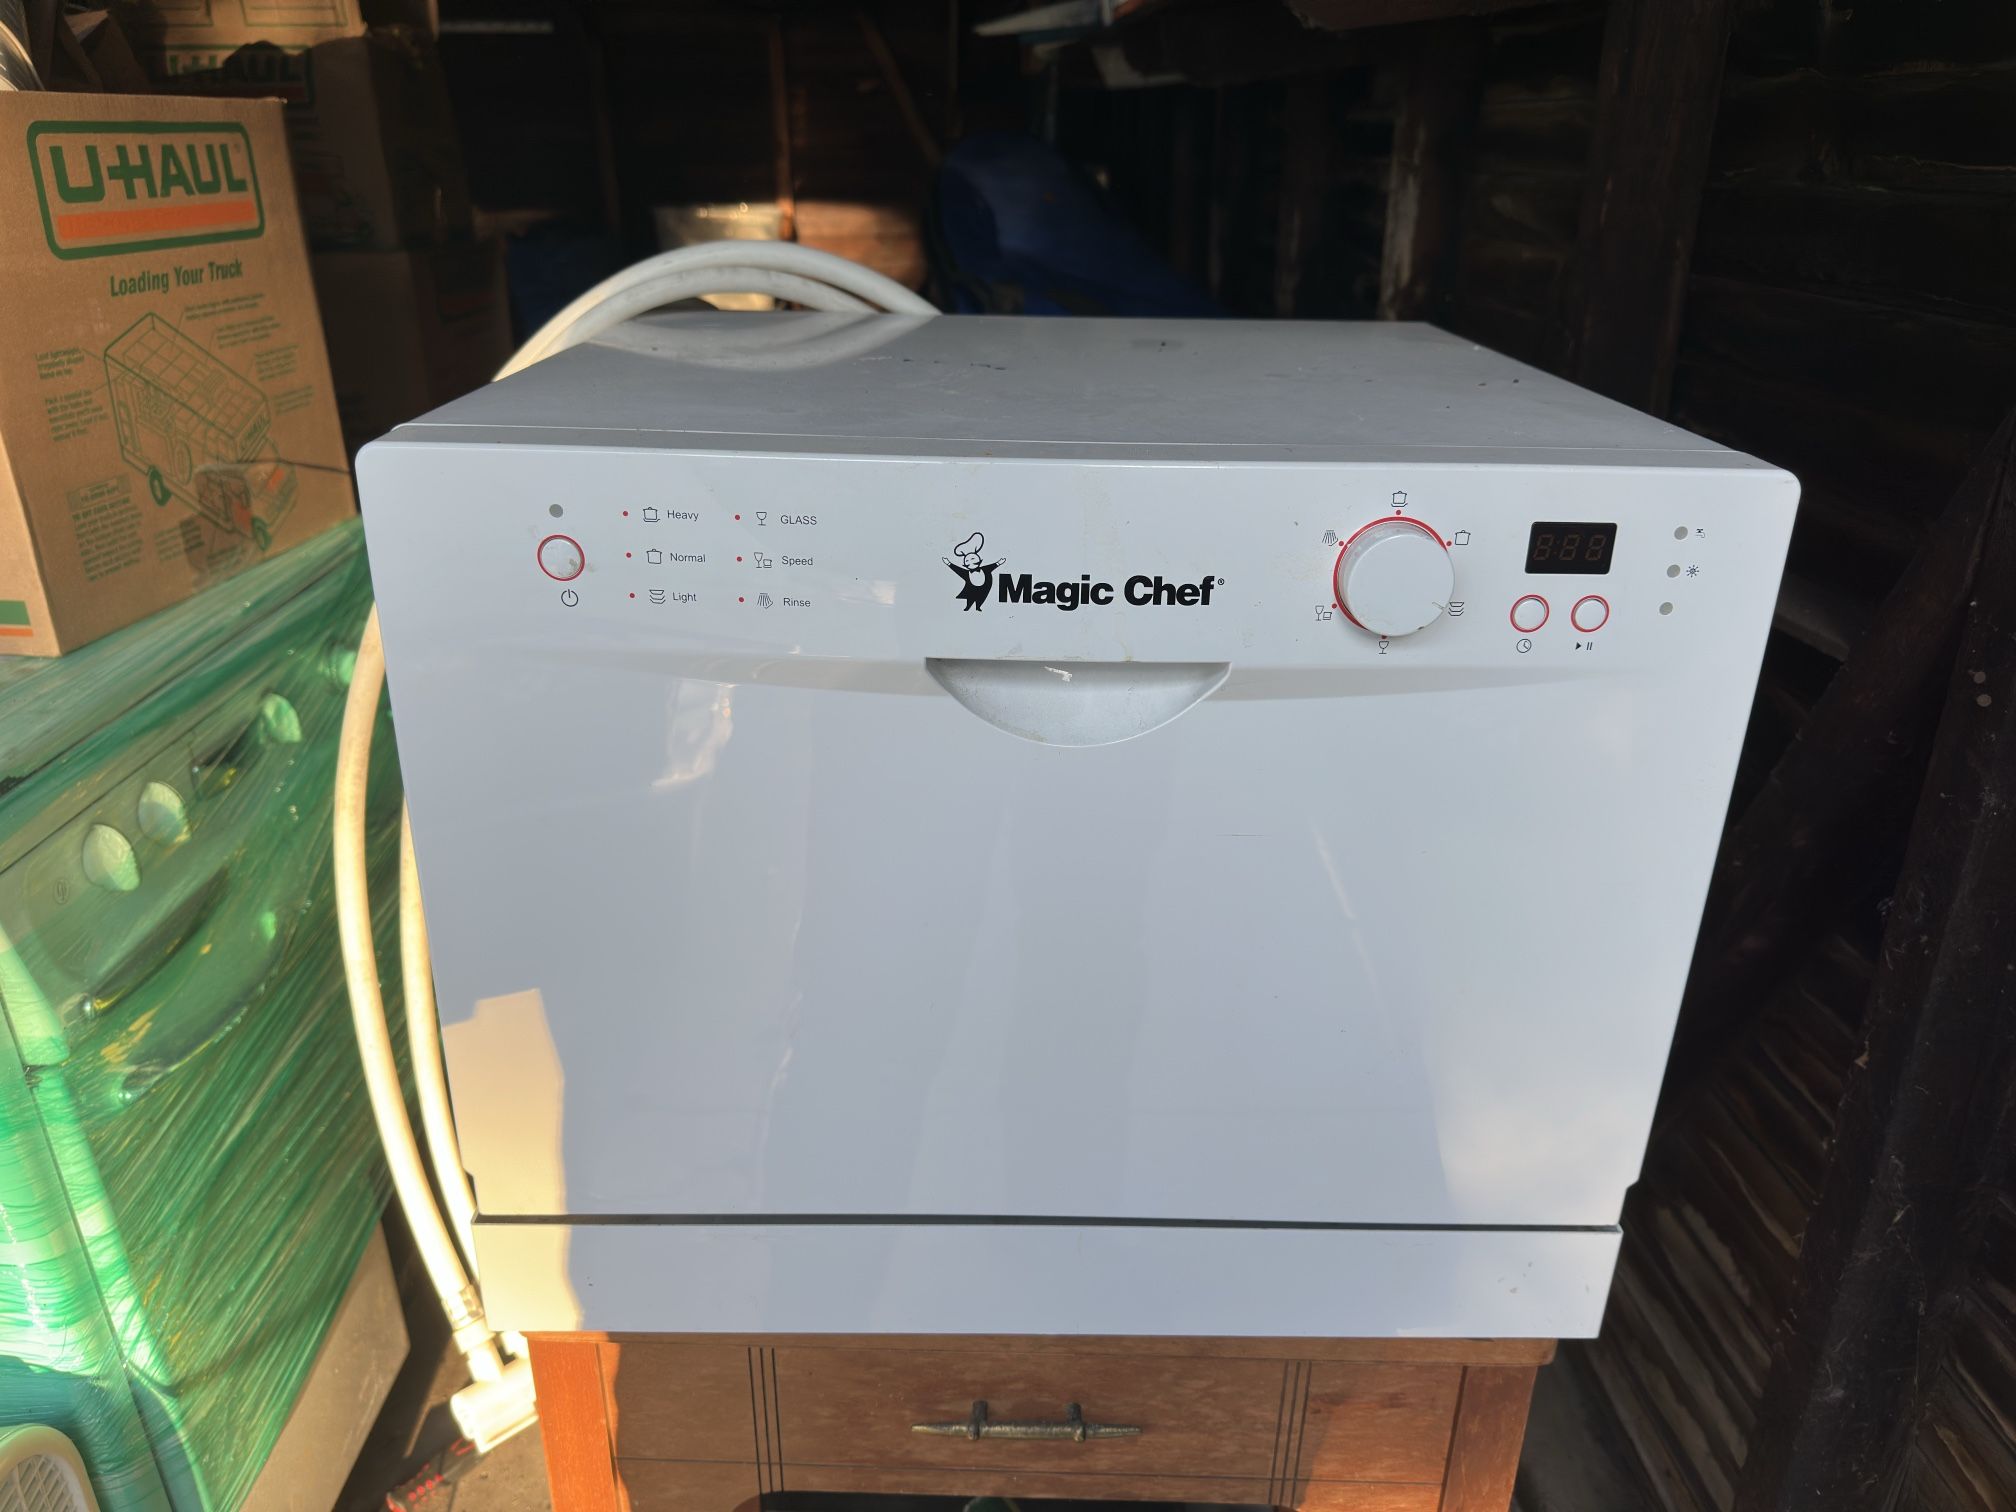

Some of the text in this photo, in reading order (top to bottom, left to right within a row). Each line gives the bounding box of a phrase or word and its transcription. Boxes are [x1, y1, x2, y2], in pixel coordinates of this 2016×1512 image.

[49, 143, 248, 204] U-HAUL
[110, 259, 243, 297] Loading Your Truck
[667, 509, 699, 523] Heavy
[780, 514, 818, 526] GLASS
[670, 552, 706, 563] Normal
[781, 555, 814, 567] Speed
[672, 591, 697, 604] Light
[998, 573, 1114, 612] Magic
[783, 597, 811, 608] Rinse
